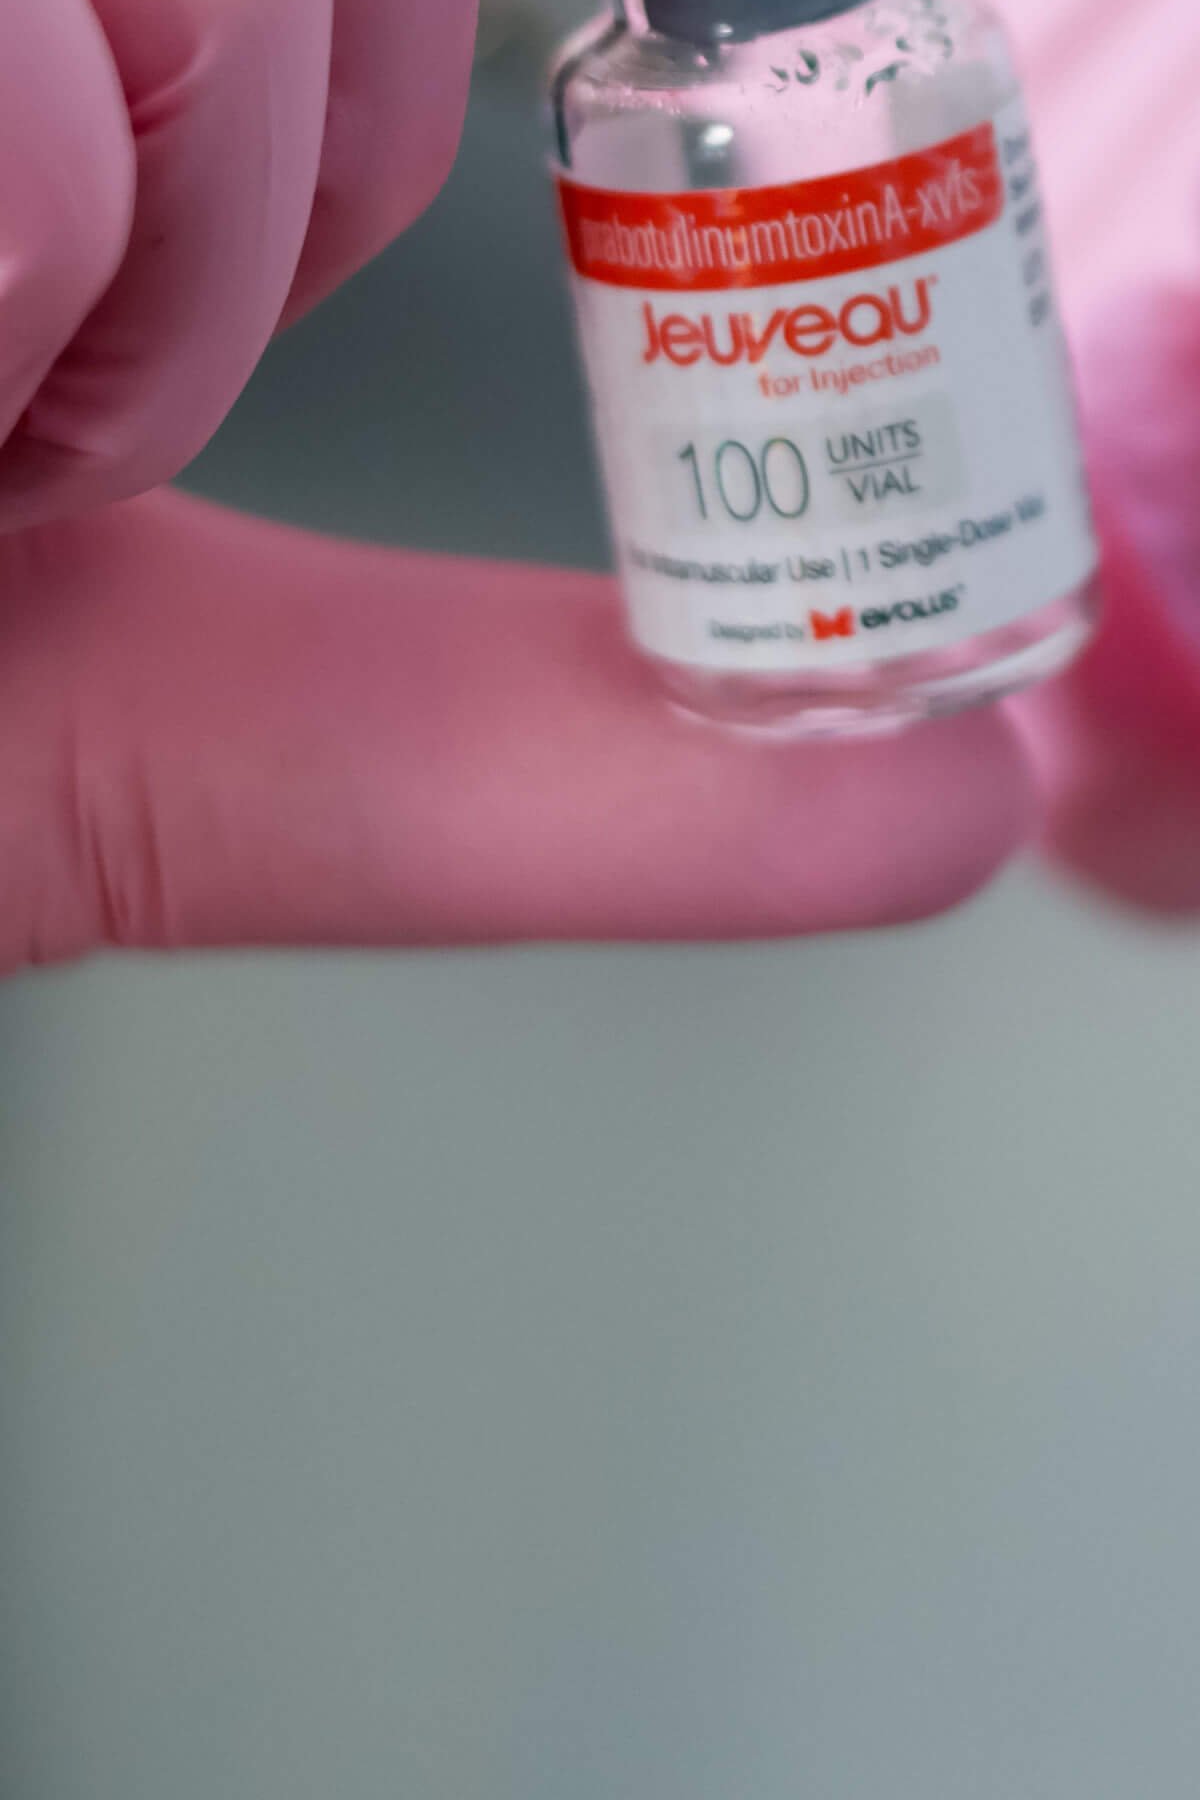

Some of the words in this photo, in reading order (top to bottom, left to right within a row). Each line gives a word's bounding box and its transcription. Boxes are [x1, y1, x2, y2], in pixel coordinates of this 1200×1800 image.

[580, 157, 982, 270] abotulinumtoxinA-xvfs
[642, 276, 932, 367] Jeuveau
[757, 371, 801, 398] for
[809, 345, 941, 396] Injection
[825, 418, 921, 465] UNITS
[677, 436, 810, 523] 100
[846, 465, 921, 504] VIAL
[786, 554, 836, 583] Use
[857, 547, 871, 573] 1
